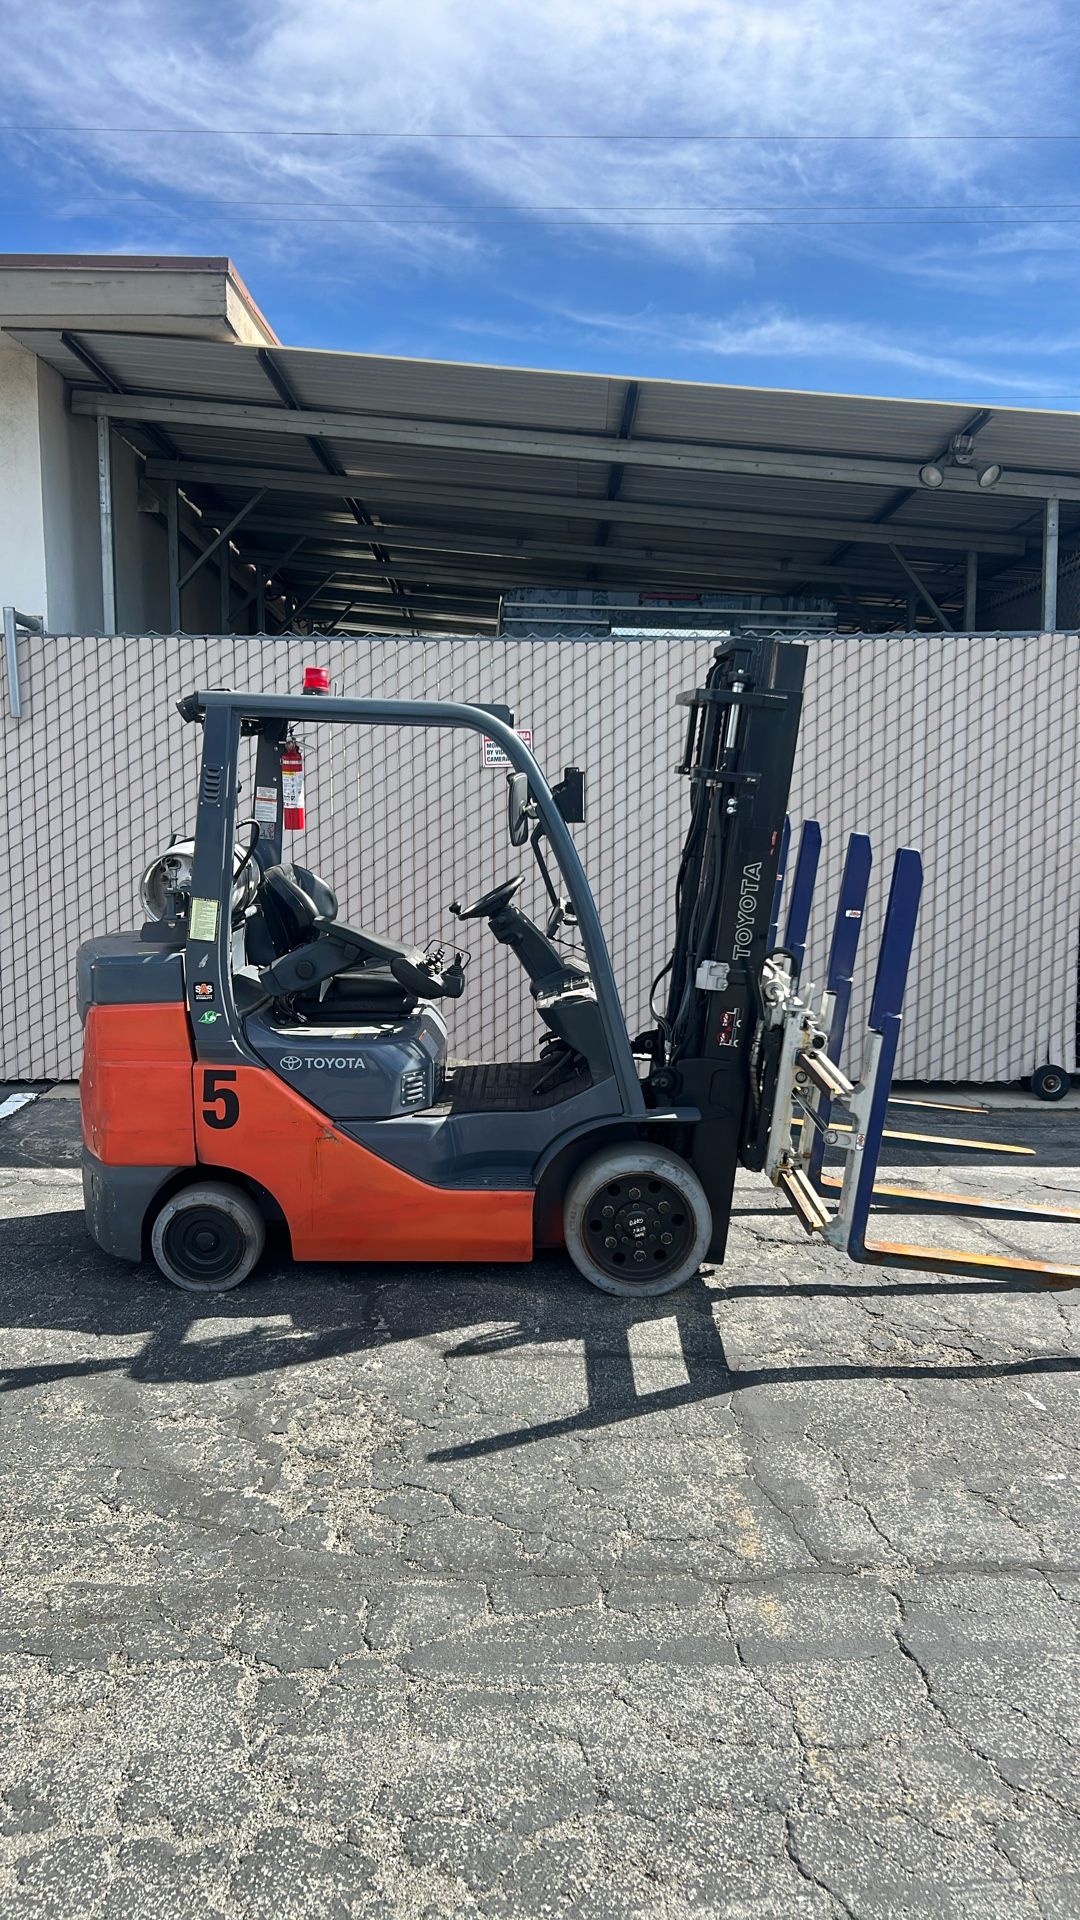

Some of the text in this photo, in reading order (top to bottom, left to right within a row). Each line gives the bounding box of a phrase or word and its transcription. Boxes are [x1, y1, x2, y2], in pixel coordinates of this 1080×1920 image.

[732, 862, 762, 960] TOYOTA
[195, 983, 213, 994] SAS
[304, 1057, 366, 1069] TOYOTA
[203, 1069, 239, 1130] 5
